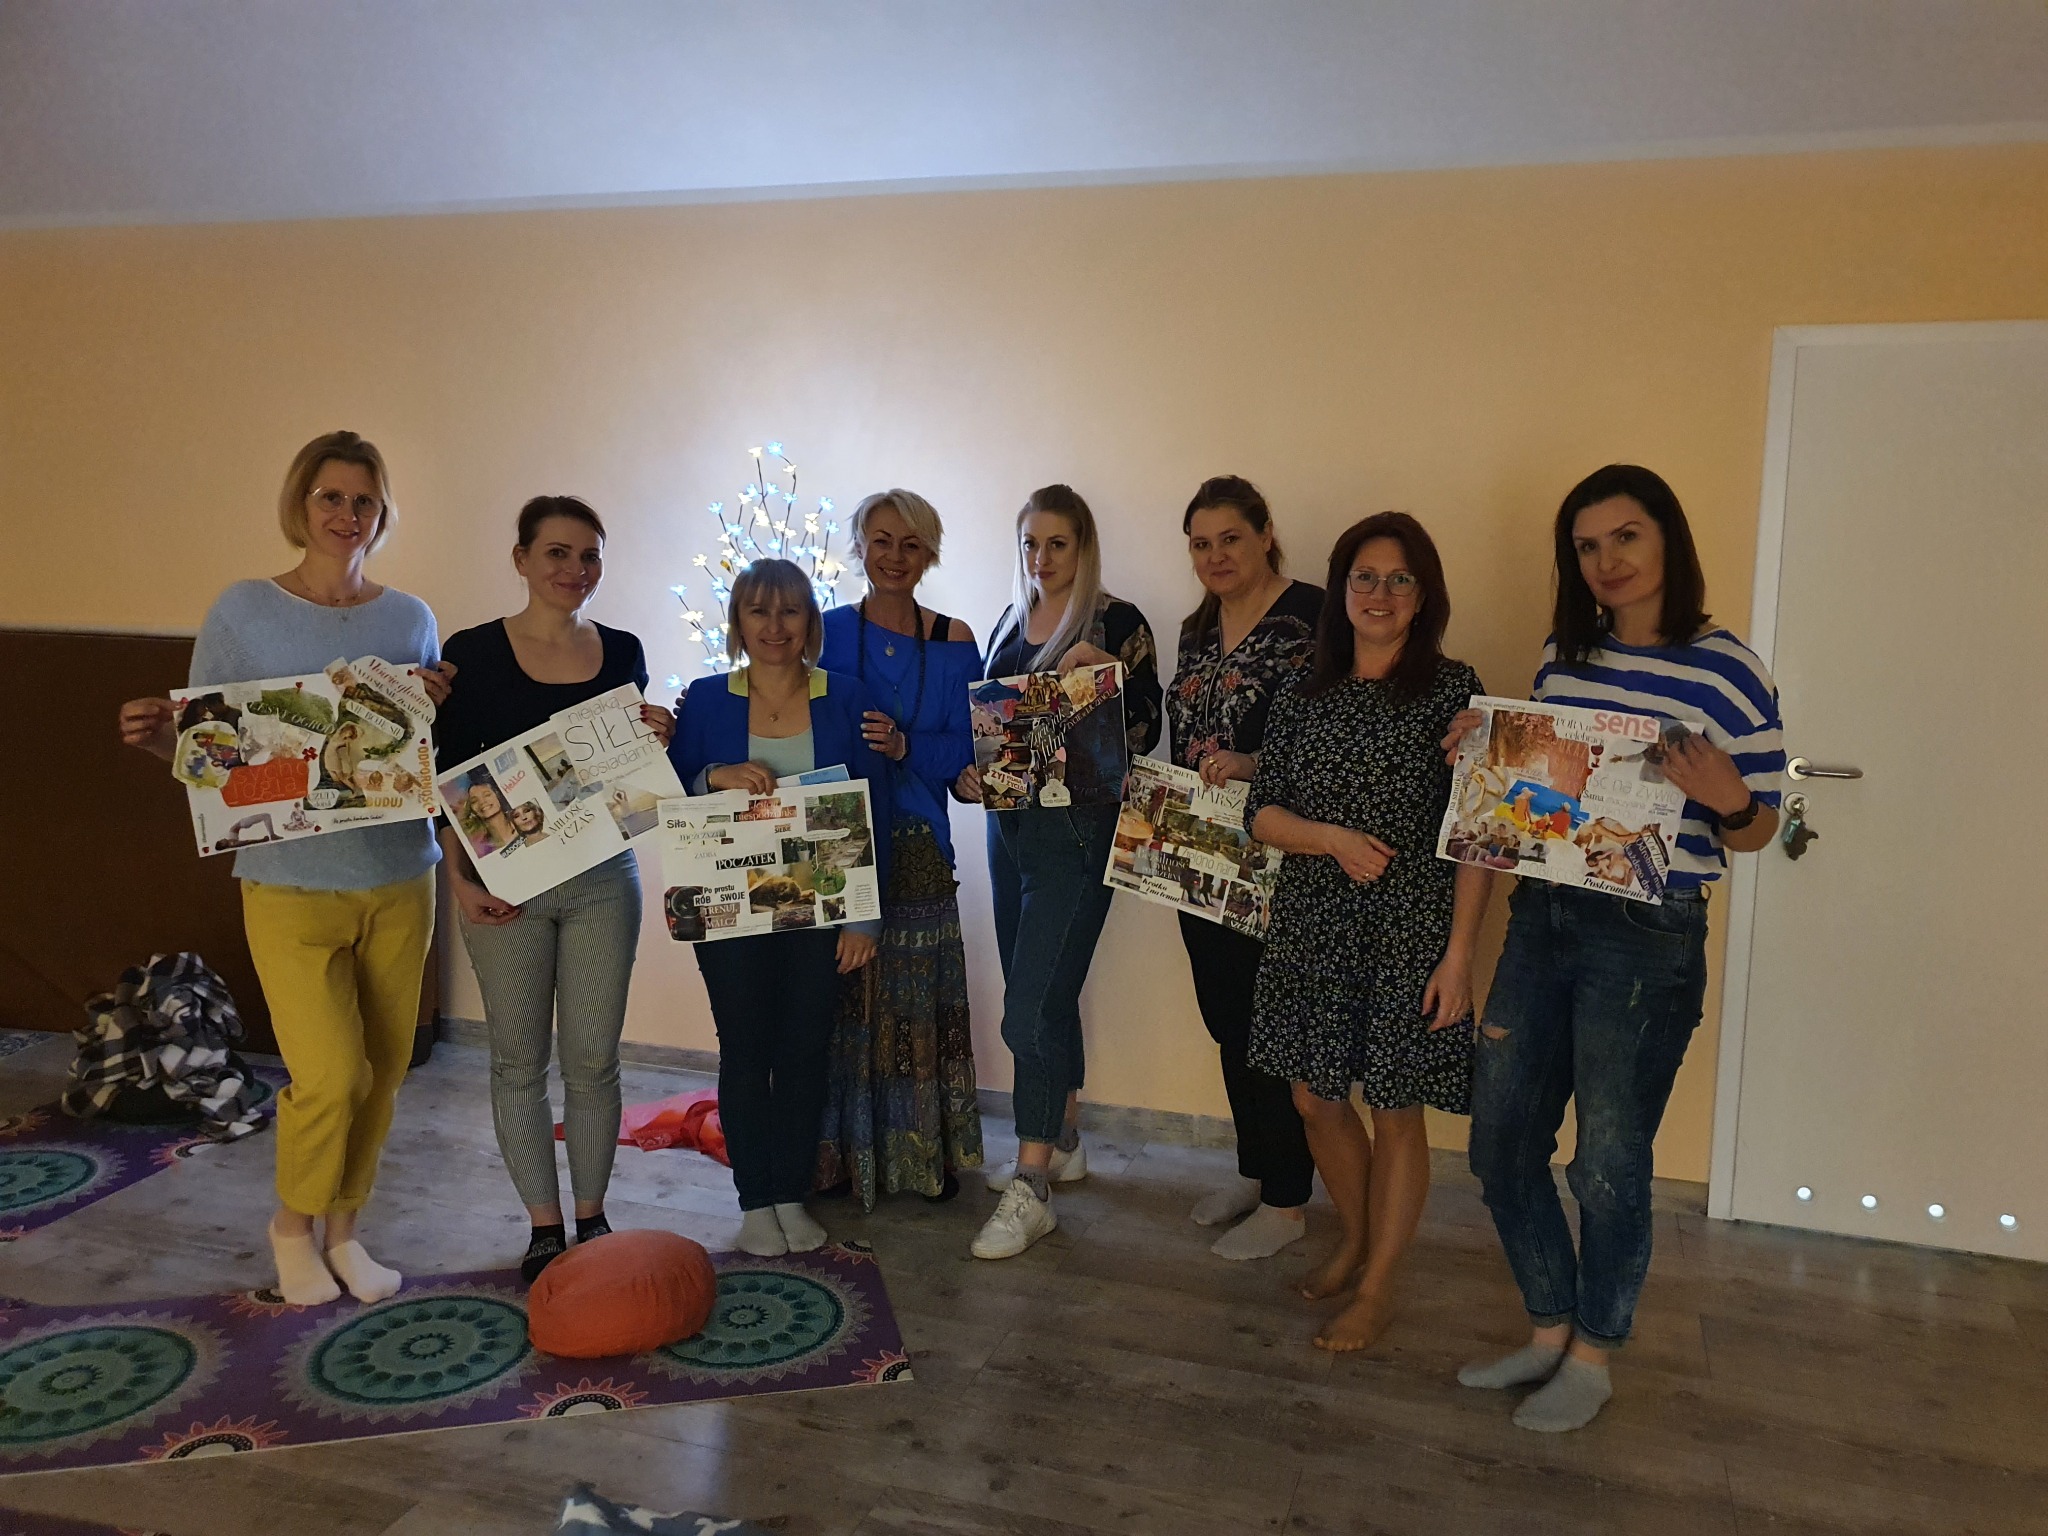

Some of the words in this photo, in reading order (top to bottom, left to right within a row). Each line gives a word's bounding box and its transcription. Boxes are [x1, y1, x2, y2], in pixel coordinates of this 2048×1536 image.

[1592, 712, 1658, 739] sens
[563, 809, 596, 839] CZAS
[666, 819, 687, 829] Siła
[719, 853, 775, 870] POCZĄTEK
[714, 884, 735, 894] prostu
[694, 895, 711, 905] RÓB
[720, 892, 746, 902] SWOJE
